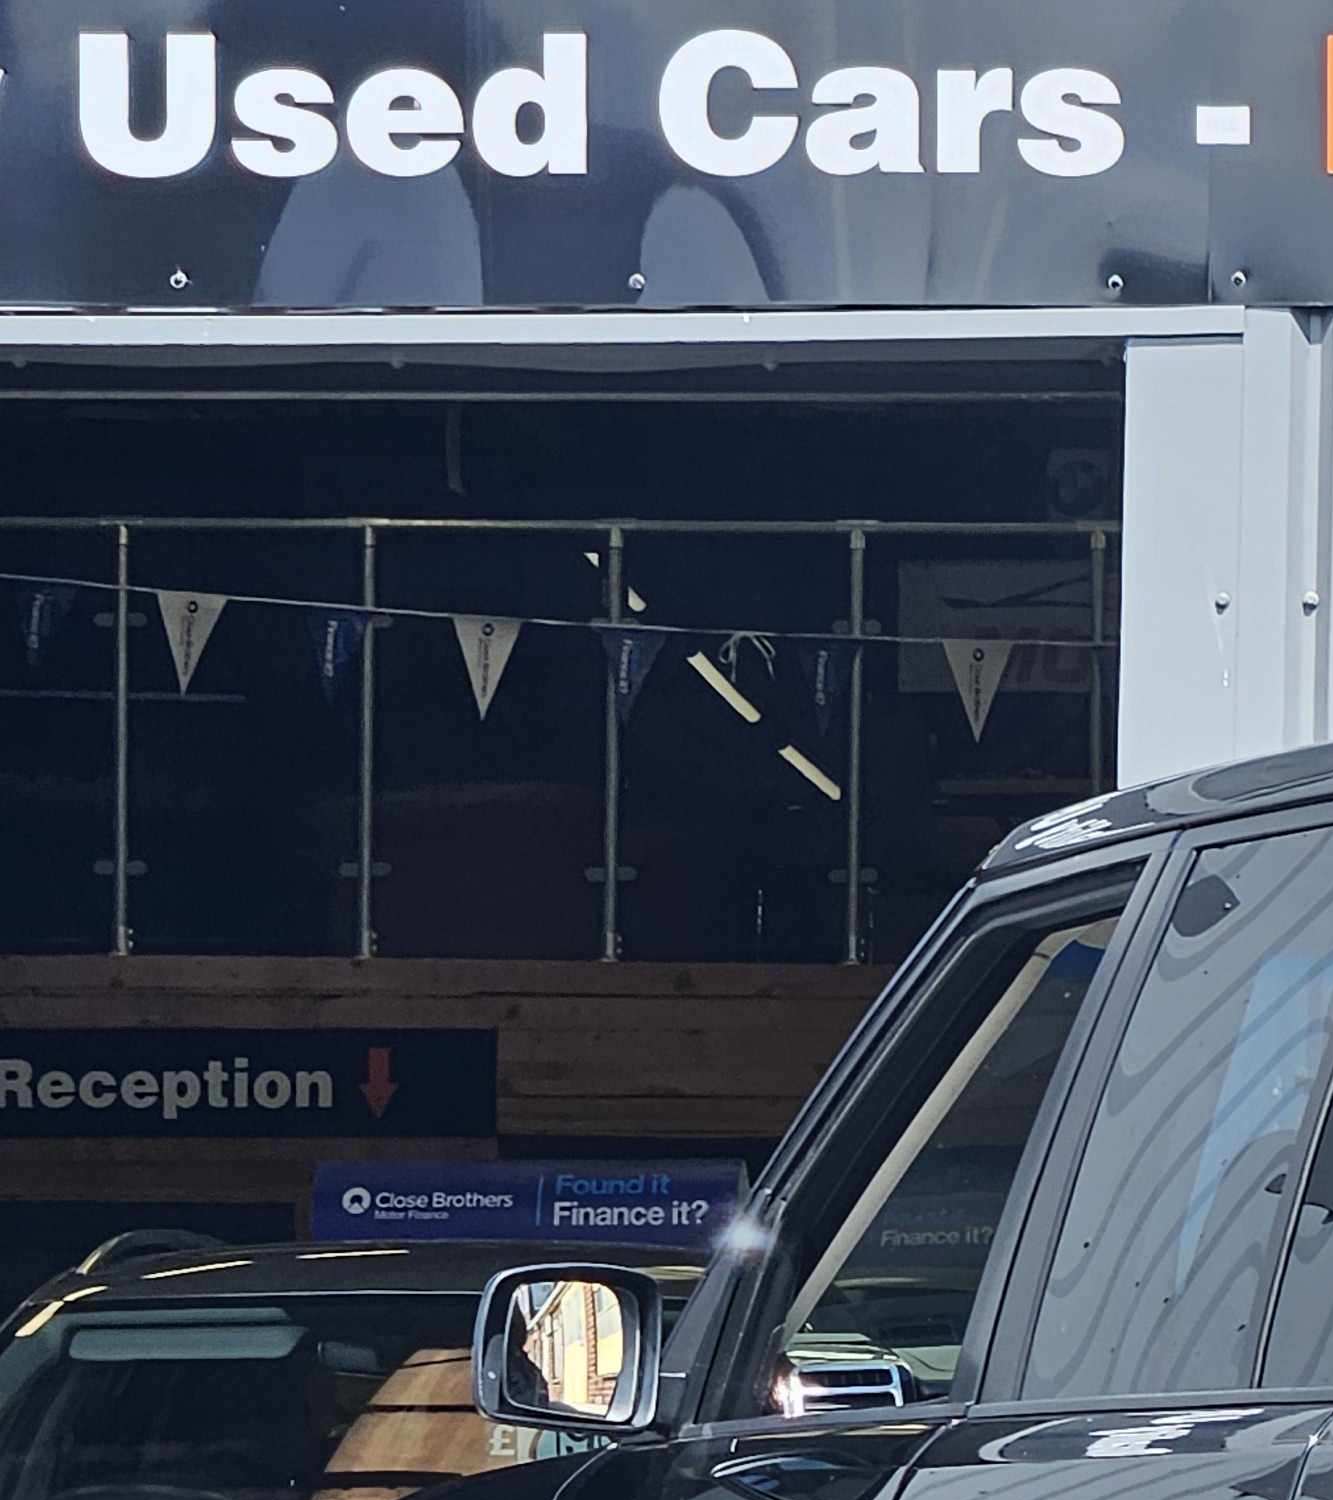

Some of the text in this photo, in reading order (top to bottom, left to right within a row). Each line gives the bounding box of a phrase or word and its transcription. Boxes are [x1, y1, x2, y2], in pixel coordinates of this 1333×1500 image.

[79, 33, 587, 178] Used
[659, 29, 1124, 177] Cars
[1196, 105, 1251, 145] -
[0, 1057, 333, 1120] Reception
[555, 1173, 671, 1196] Found it
[375, 1191, 514, 1209] Close Brothers
[553, 1200, 710, 1226] Finance it?
[880, 1225, 994, 1248] Finance it?
